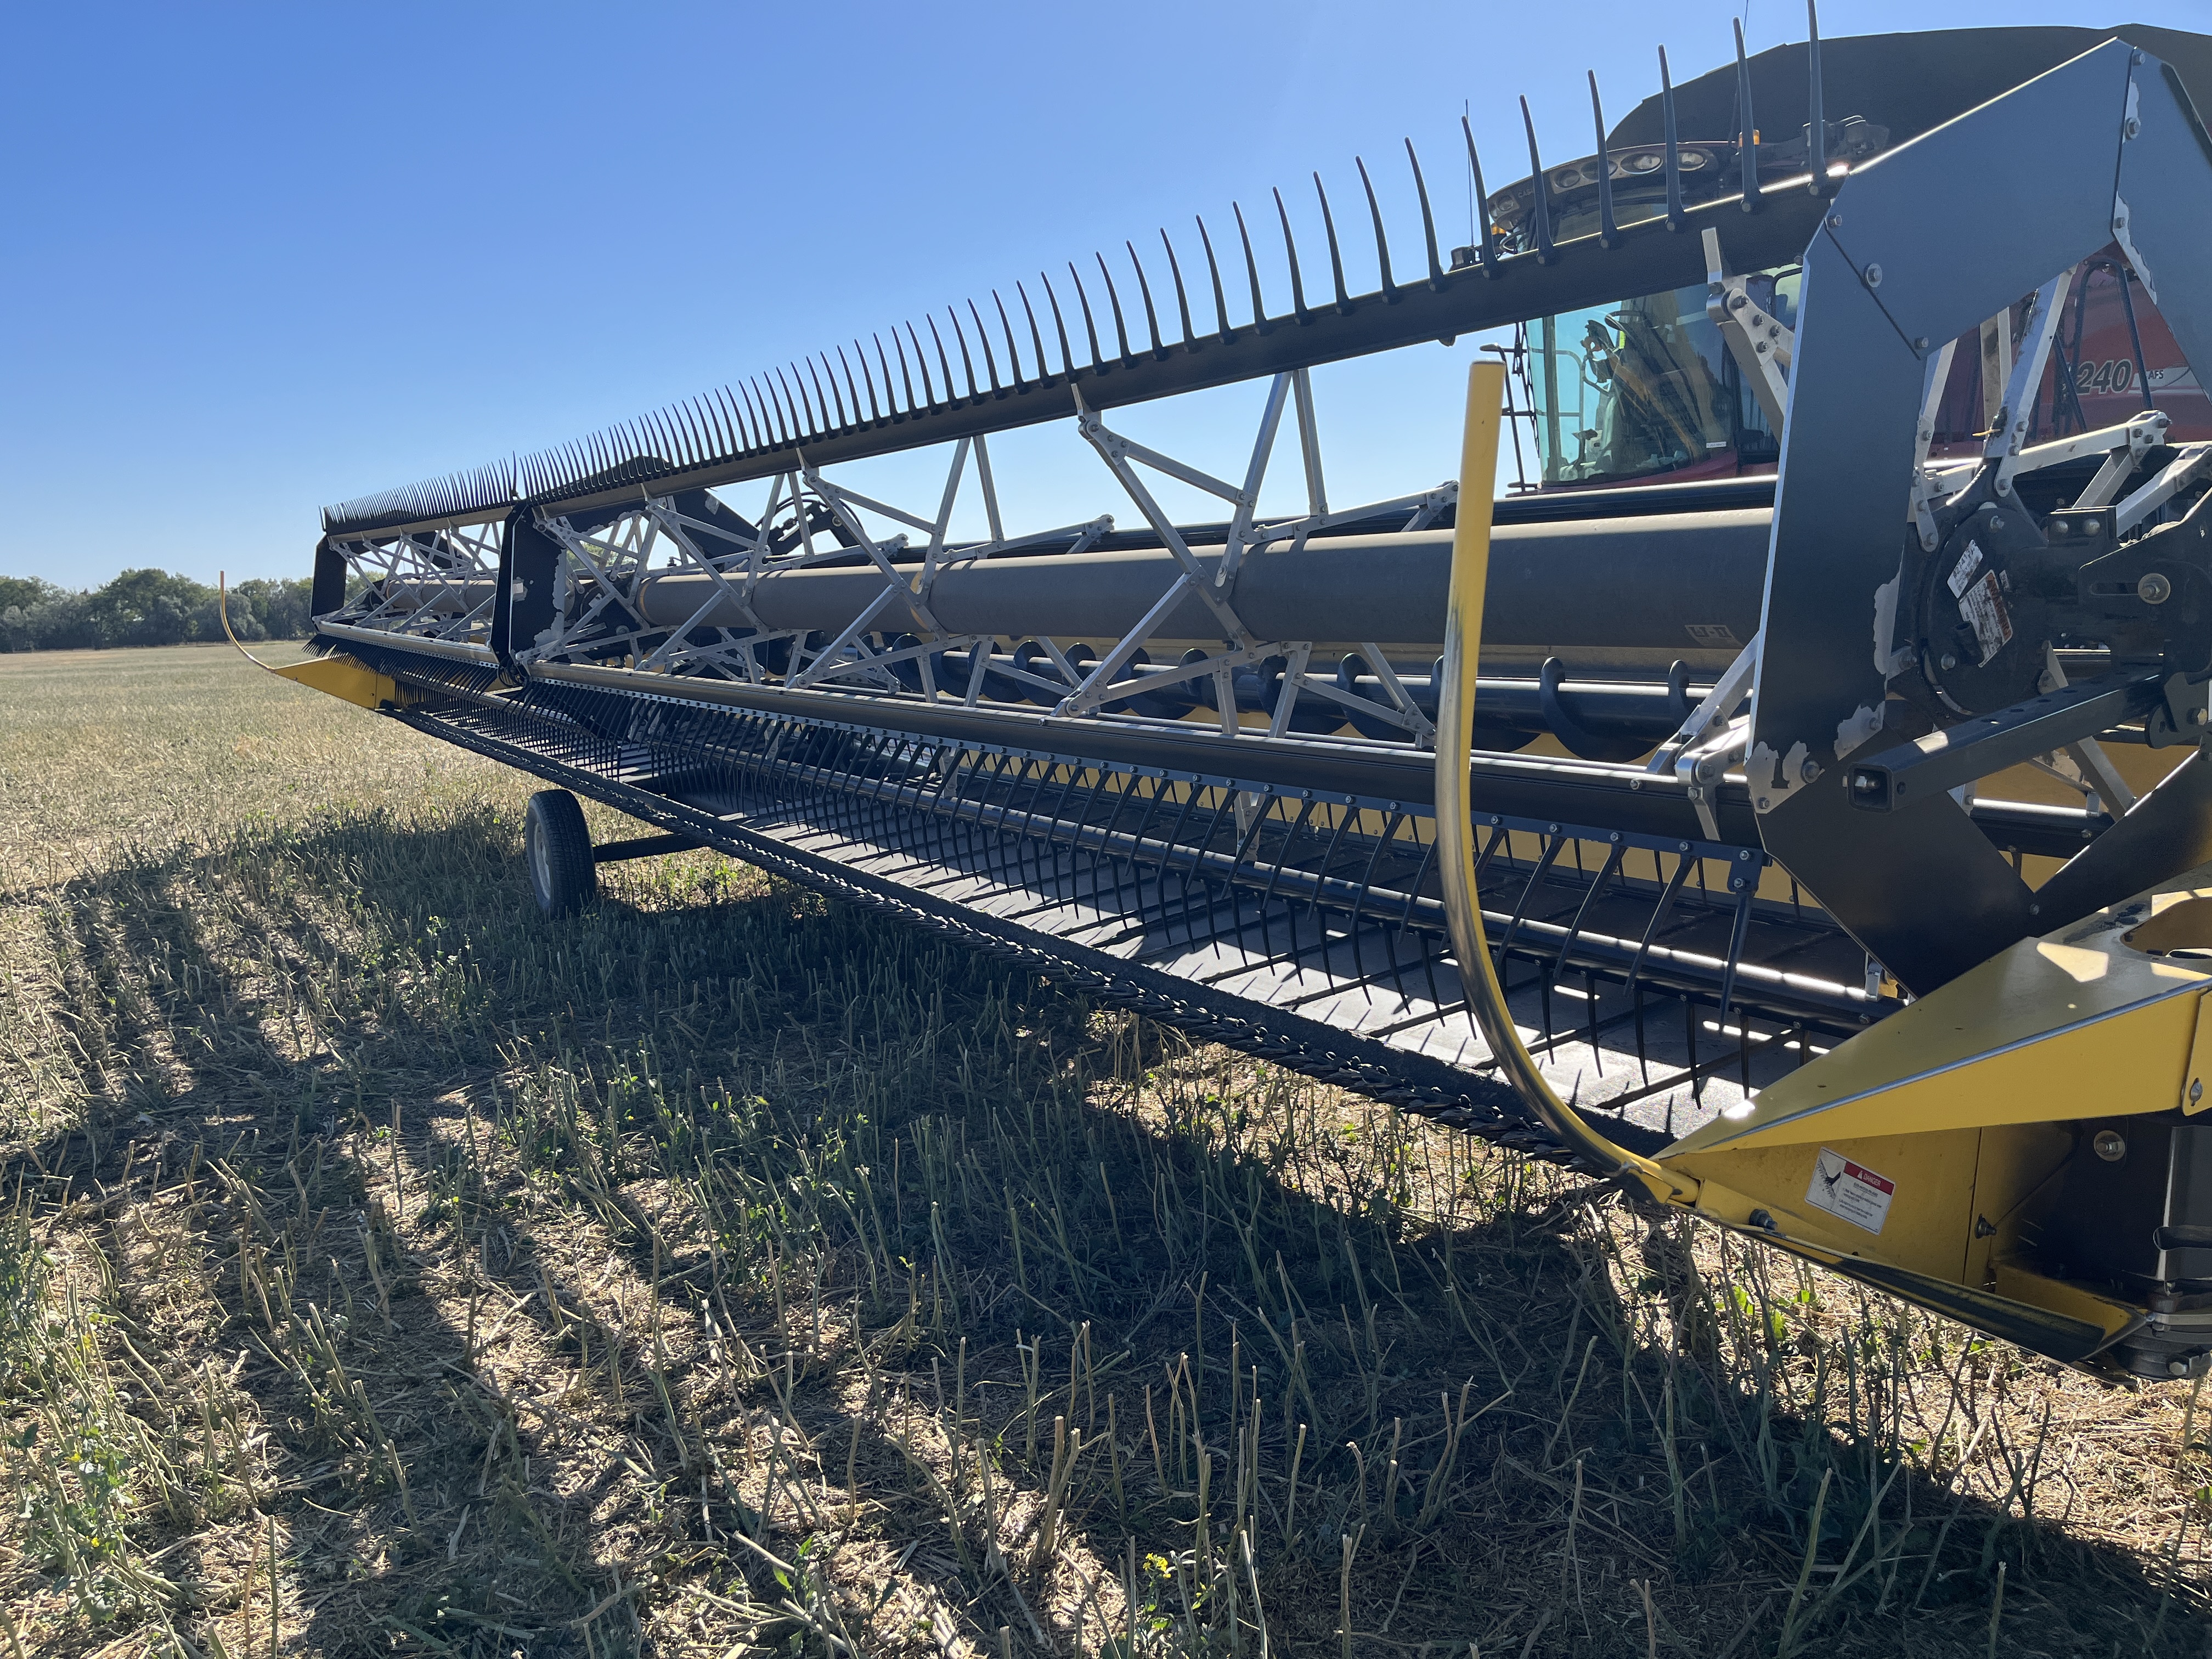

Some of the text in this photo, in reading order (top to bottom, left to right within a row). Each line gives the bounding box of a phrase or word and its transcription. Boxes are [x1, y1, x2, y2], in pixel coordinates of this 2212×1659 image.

[2063, 359, 2164, 395] 240 AFS
[1863, 1173, 1881, 1187] DANGER
